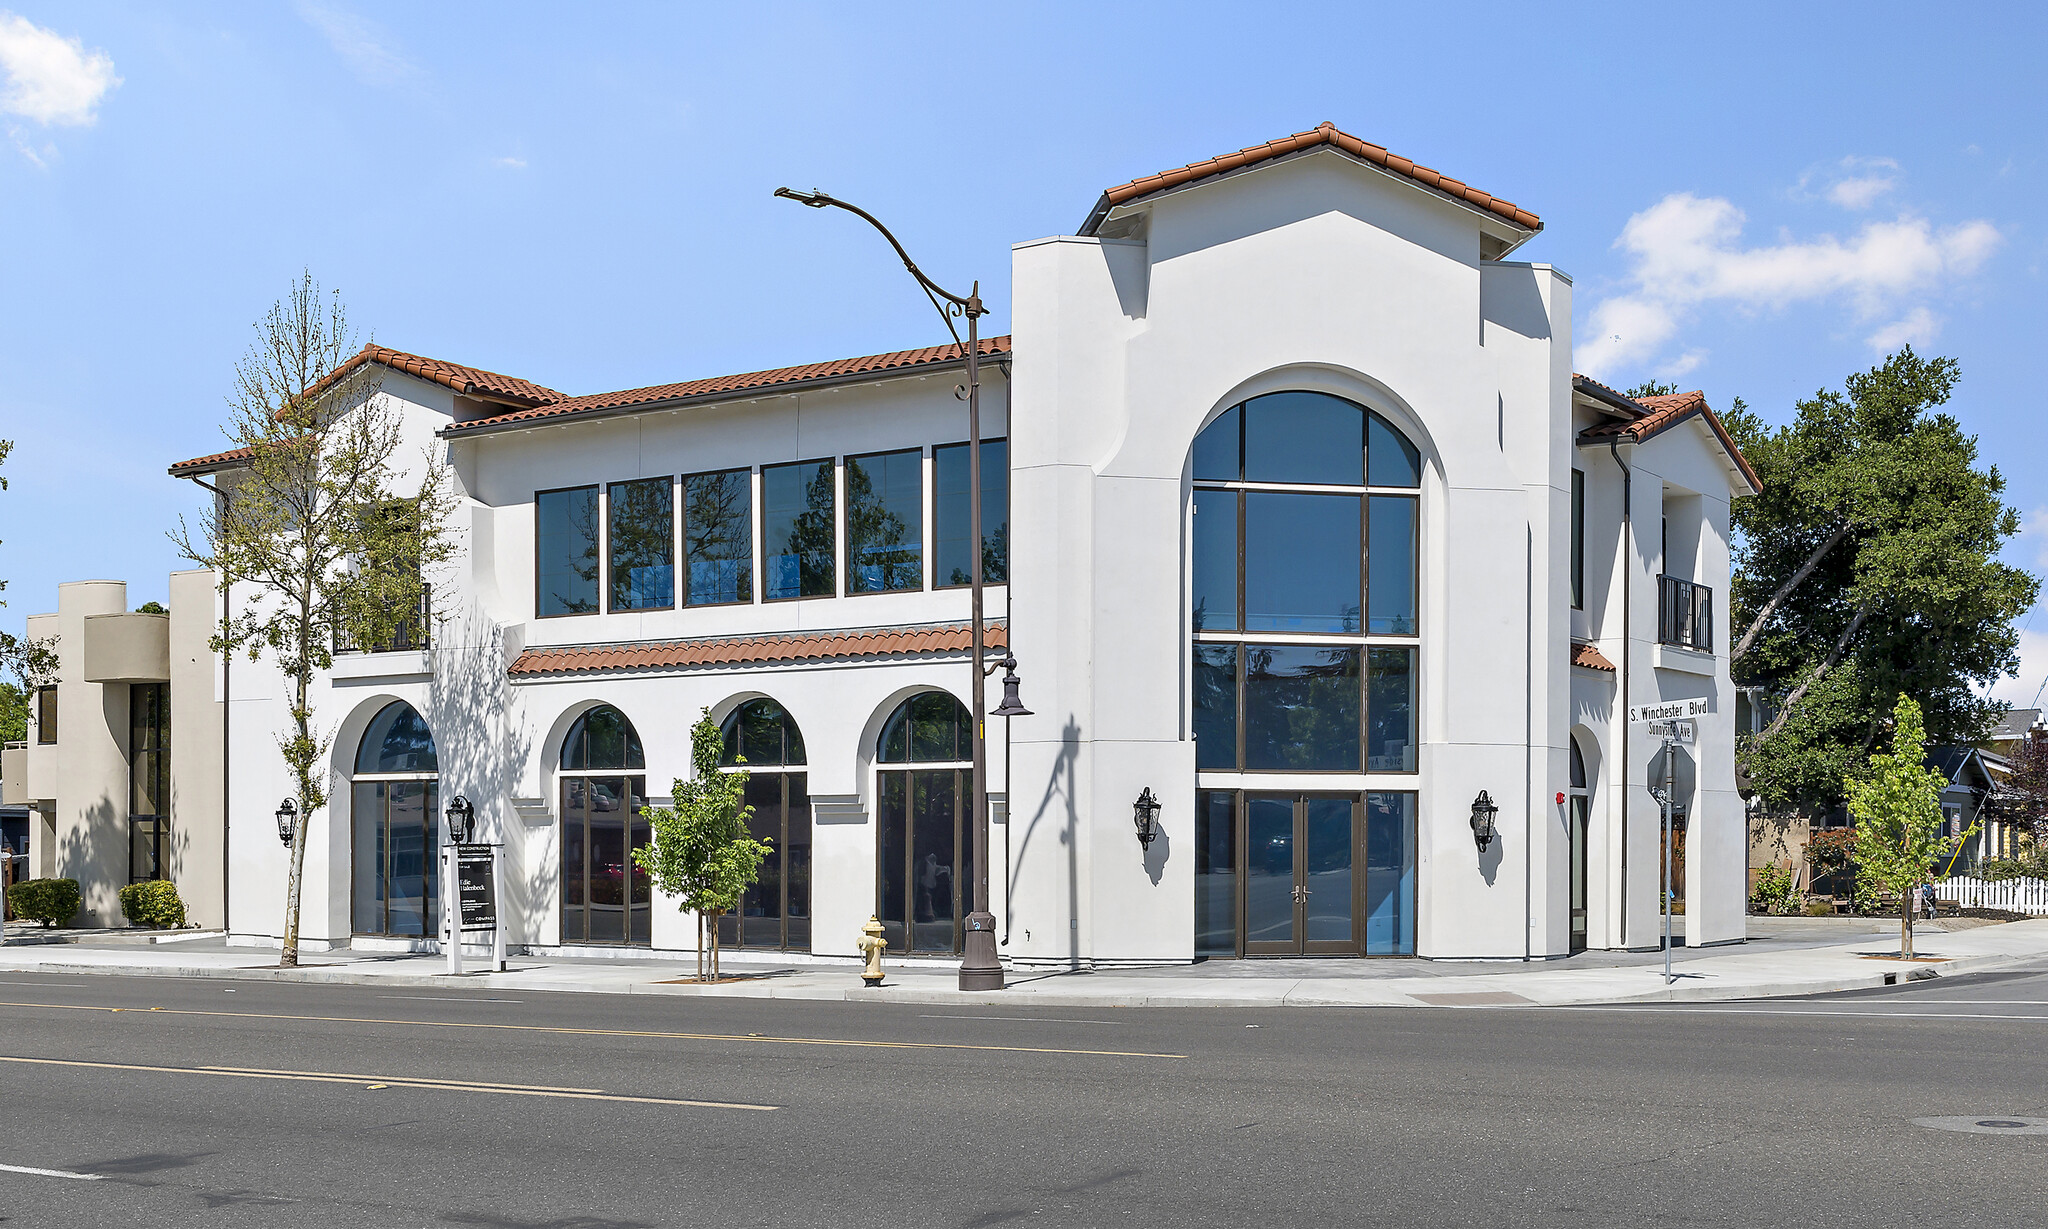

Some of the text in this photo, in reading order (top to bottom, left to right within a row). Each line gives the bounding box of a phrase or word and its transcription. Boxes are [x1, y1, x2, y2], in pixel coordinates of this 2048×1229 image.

[1631, 701, 1707, 721] S. Winchester Blvd
[1680, 724, 1690, 738] Ave
